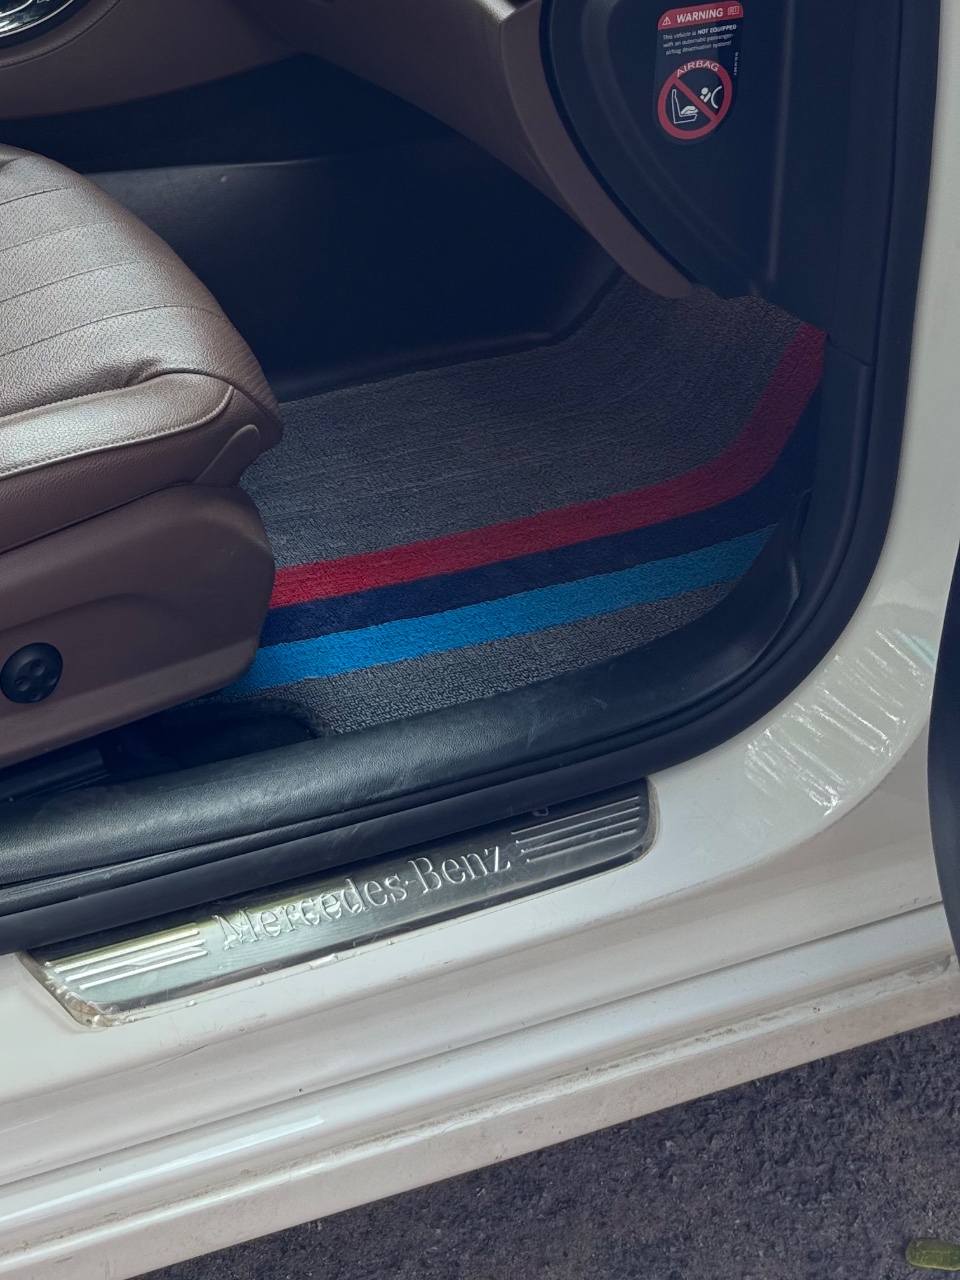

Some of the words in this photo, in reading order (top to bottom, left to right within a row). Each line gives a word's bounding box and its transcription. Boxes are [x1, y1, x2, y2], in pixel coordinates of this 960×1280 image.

[676, 8, 724, 23] WARNING
[676, 60, 720, 77] AIRBAG
[214, 844, 512, 950] Mercedes-Benz
